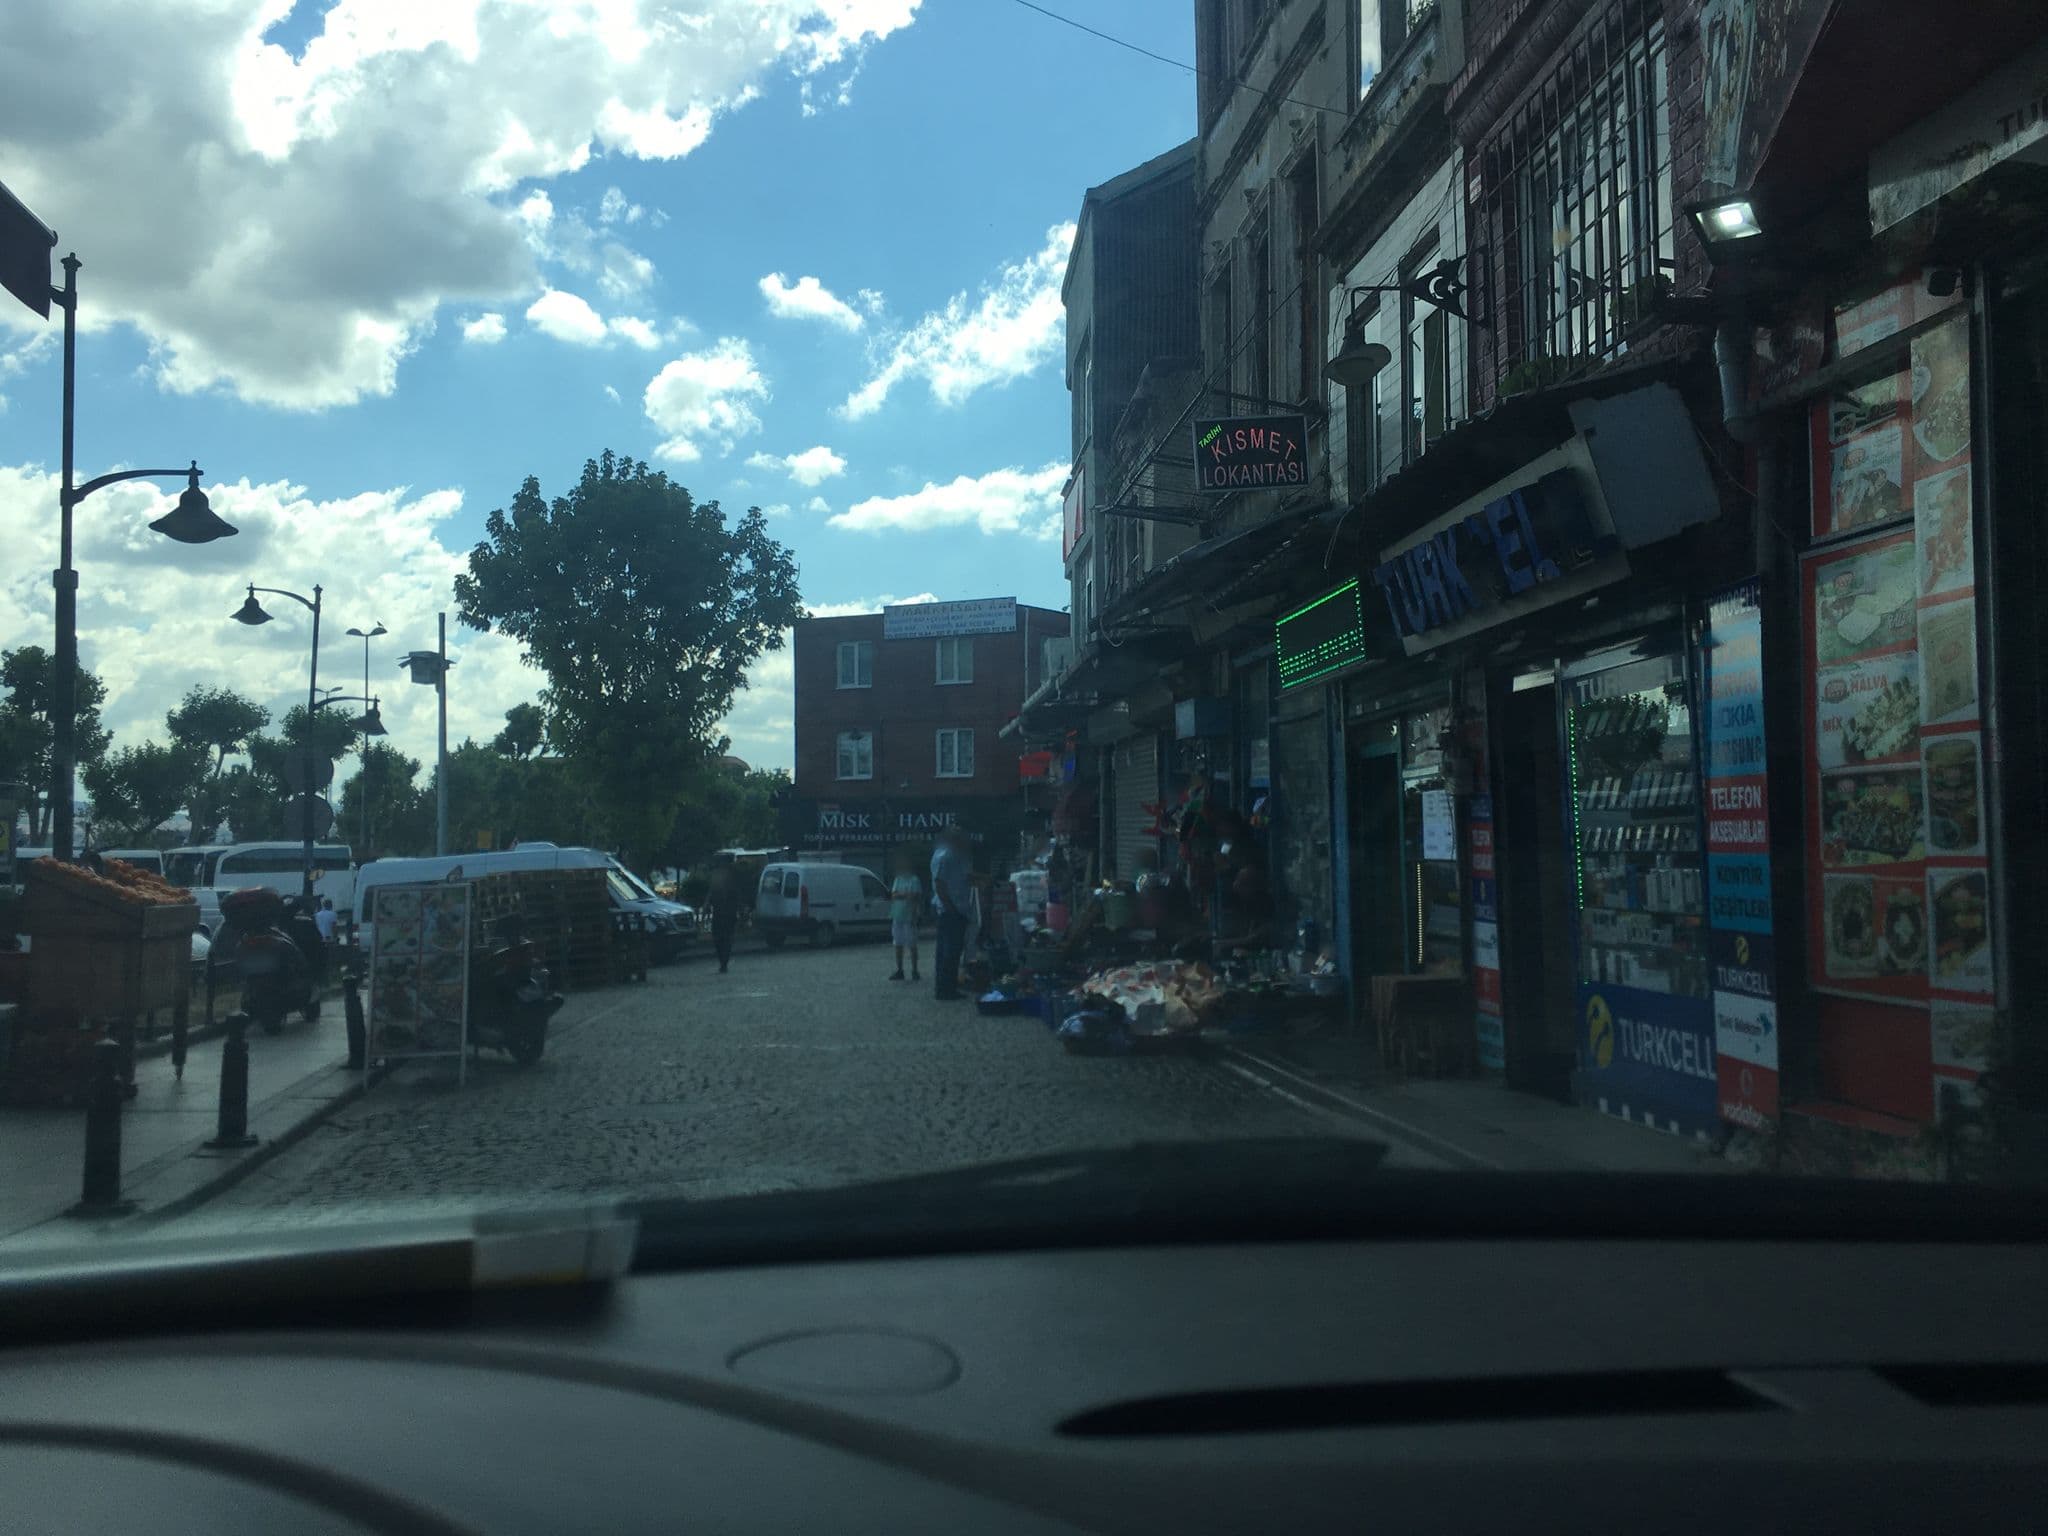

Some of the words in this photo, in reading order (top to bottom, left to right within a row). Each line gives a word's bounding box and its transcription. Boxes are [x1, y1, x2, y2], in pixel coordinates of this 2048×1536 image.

[1211, 428, 1297, 462] KISMET
[1204, 461, 1305, 487] LOKANTASI
[1710, 786, 1762, 811] TELEFON
[1716, 966, 1771, 995] TURKCELL
[1617, 1017, 1718, 1081] TURKCELL
